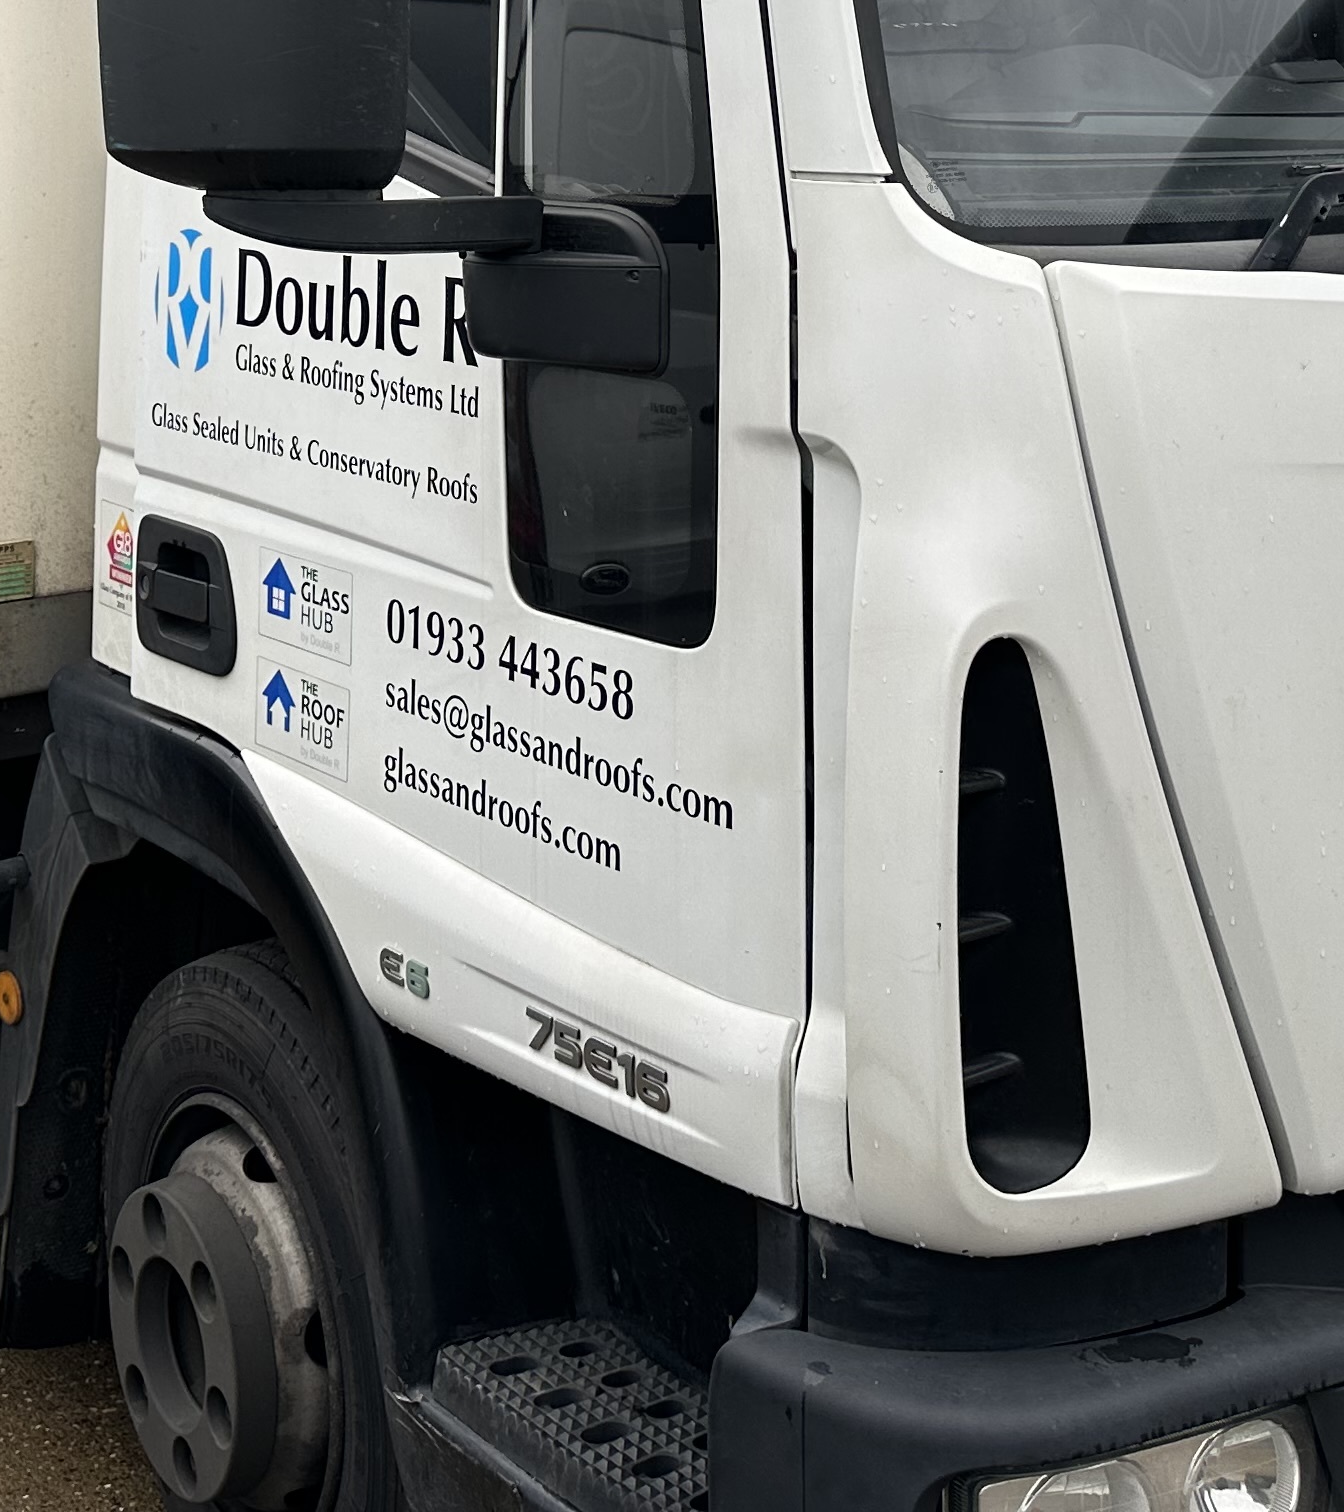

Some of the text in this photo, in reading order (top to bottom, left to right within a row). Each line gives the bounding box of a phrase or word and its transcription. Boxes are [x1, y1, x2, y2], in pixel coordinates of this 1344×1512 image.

[236, 248, 420, 356] Double
[235, 343, 480, 418] Glass & Roofing Systems Ltd
[151, 402, 479, 504] Glass Sealed Units & Conservatory Roofs
[300, 565, 319, 583] THE
[300, 581, 350, 615] GLASS
[300, 603, 334, 634] HUB
[300, 678, 319, 697] THE
[386, 598, 635, 720] 01933 443658
[300, 694, 345, 729] ROOF
[300, 717, 334, 750] HUB
[385, 678, 734, 830] sales@glassandroofs.com
[383, 746, 622, 872] glassandroofs.com
[379, 946, 431, 1000] E6
[525, 1004, 671, 1114] 75E16
